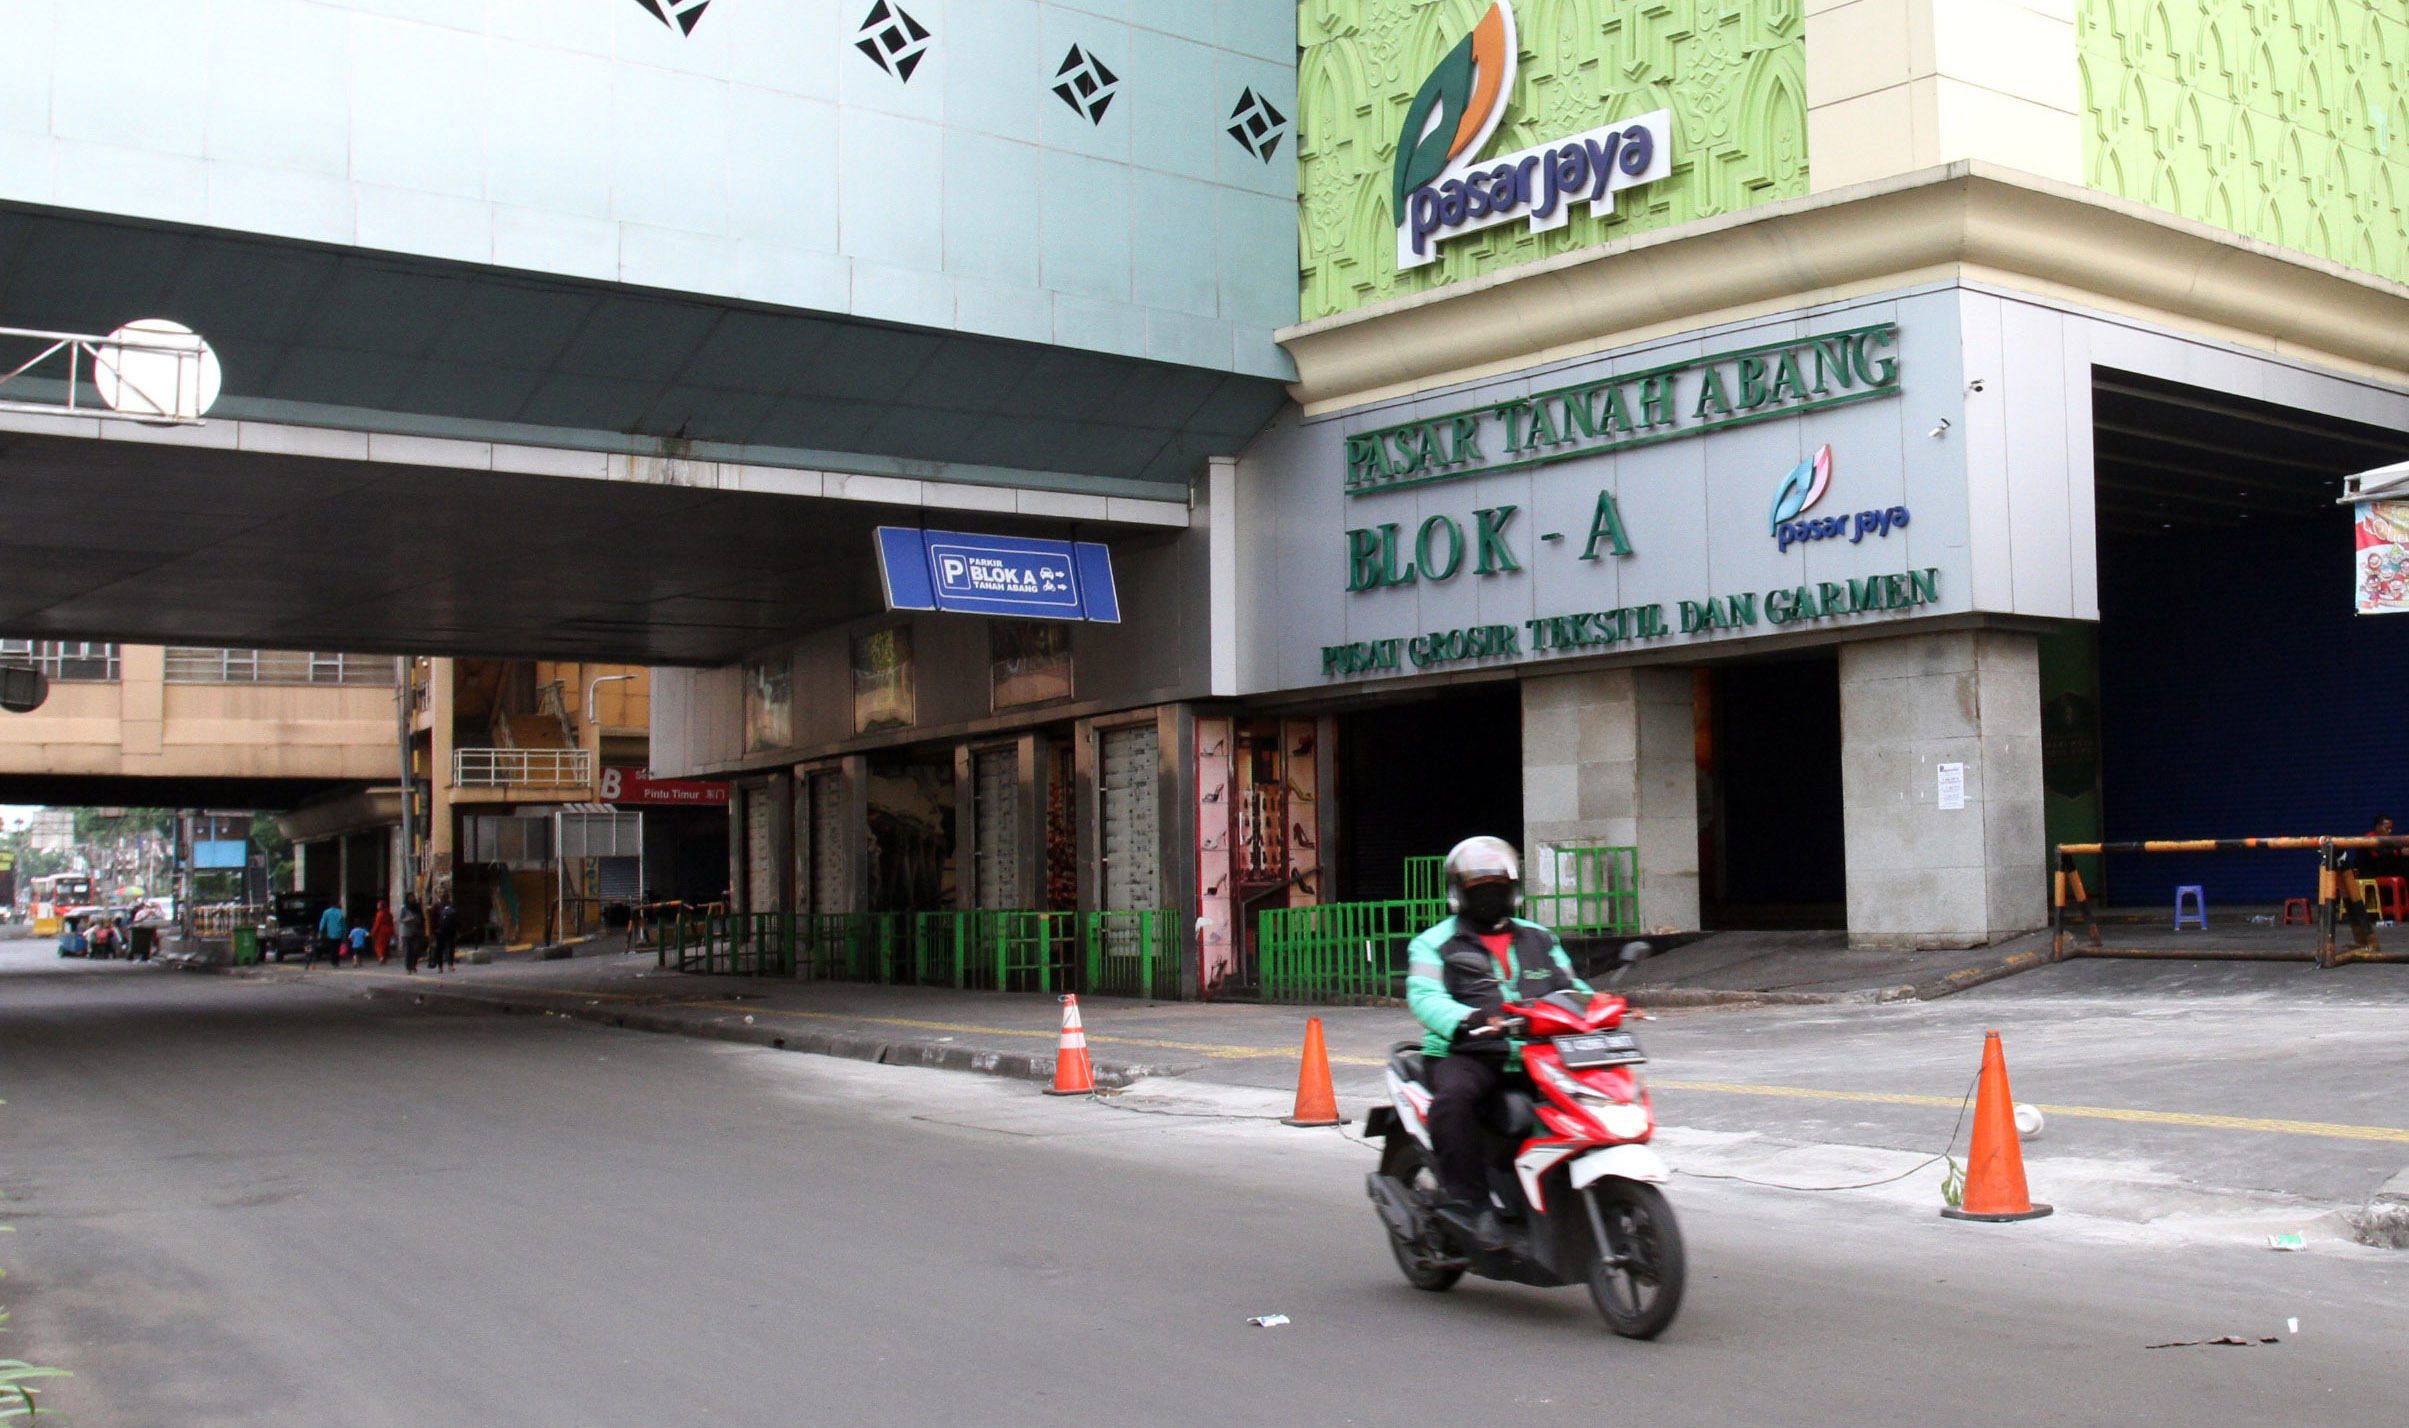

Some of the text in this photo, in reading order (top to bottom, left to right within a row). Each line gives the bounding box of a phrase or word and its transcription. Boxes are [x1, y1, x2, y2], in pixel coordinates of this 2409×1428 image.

[1411, 124, 1654, 255] pasar jaya
[1344, 330, 1898, 485] PASAR TANAH ABANG
[1345, 505, 1522, 592] BLOK
[1578, 489, 1634, 560] A
[1778, 505, 1910, 553] pasar jaya
[944, 559, 964, 584] P
[969, 558, 1003, 567] PARKIR
[970, 566, 1037, 585] BLOK A
[973, 581, 1038, 593] TANAH ABANG
[1321, 568, 1939, 675] PUSAT GROSIR TEKSTIL DAN GARMEN
[601, 768, 621, 799] B
[644, 789, 700, 799] Pintu Timur
